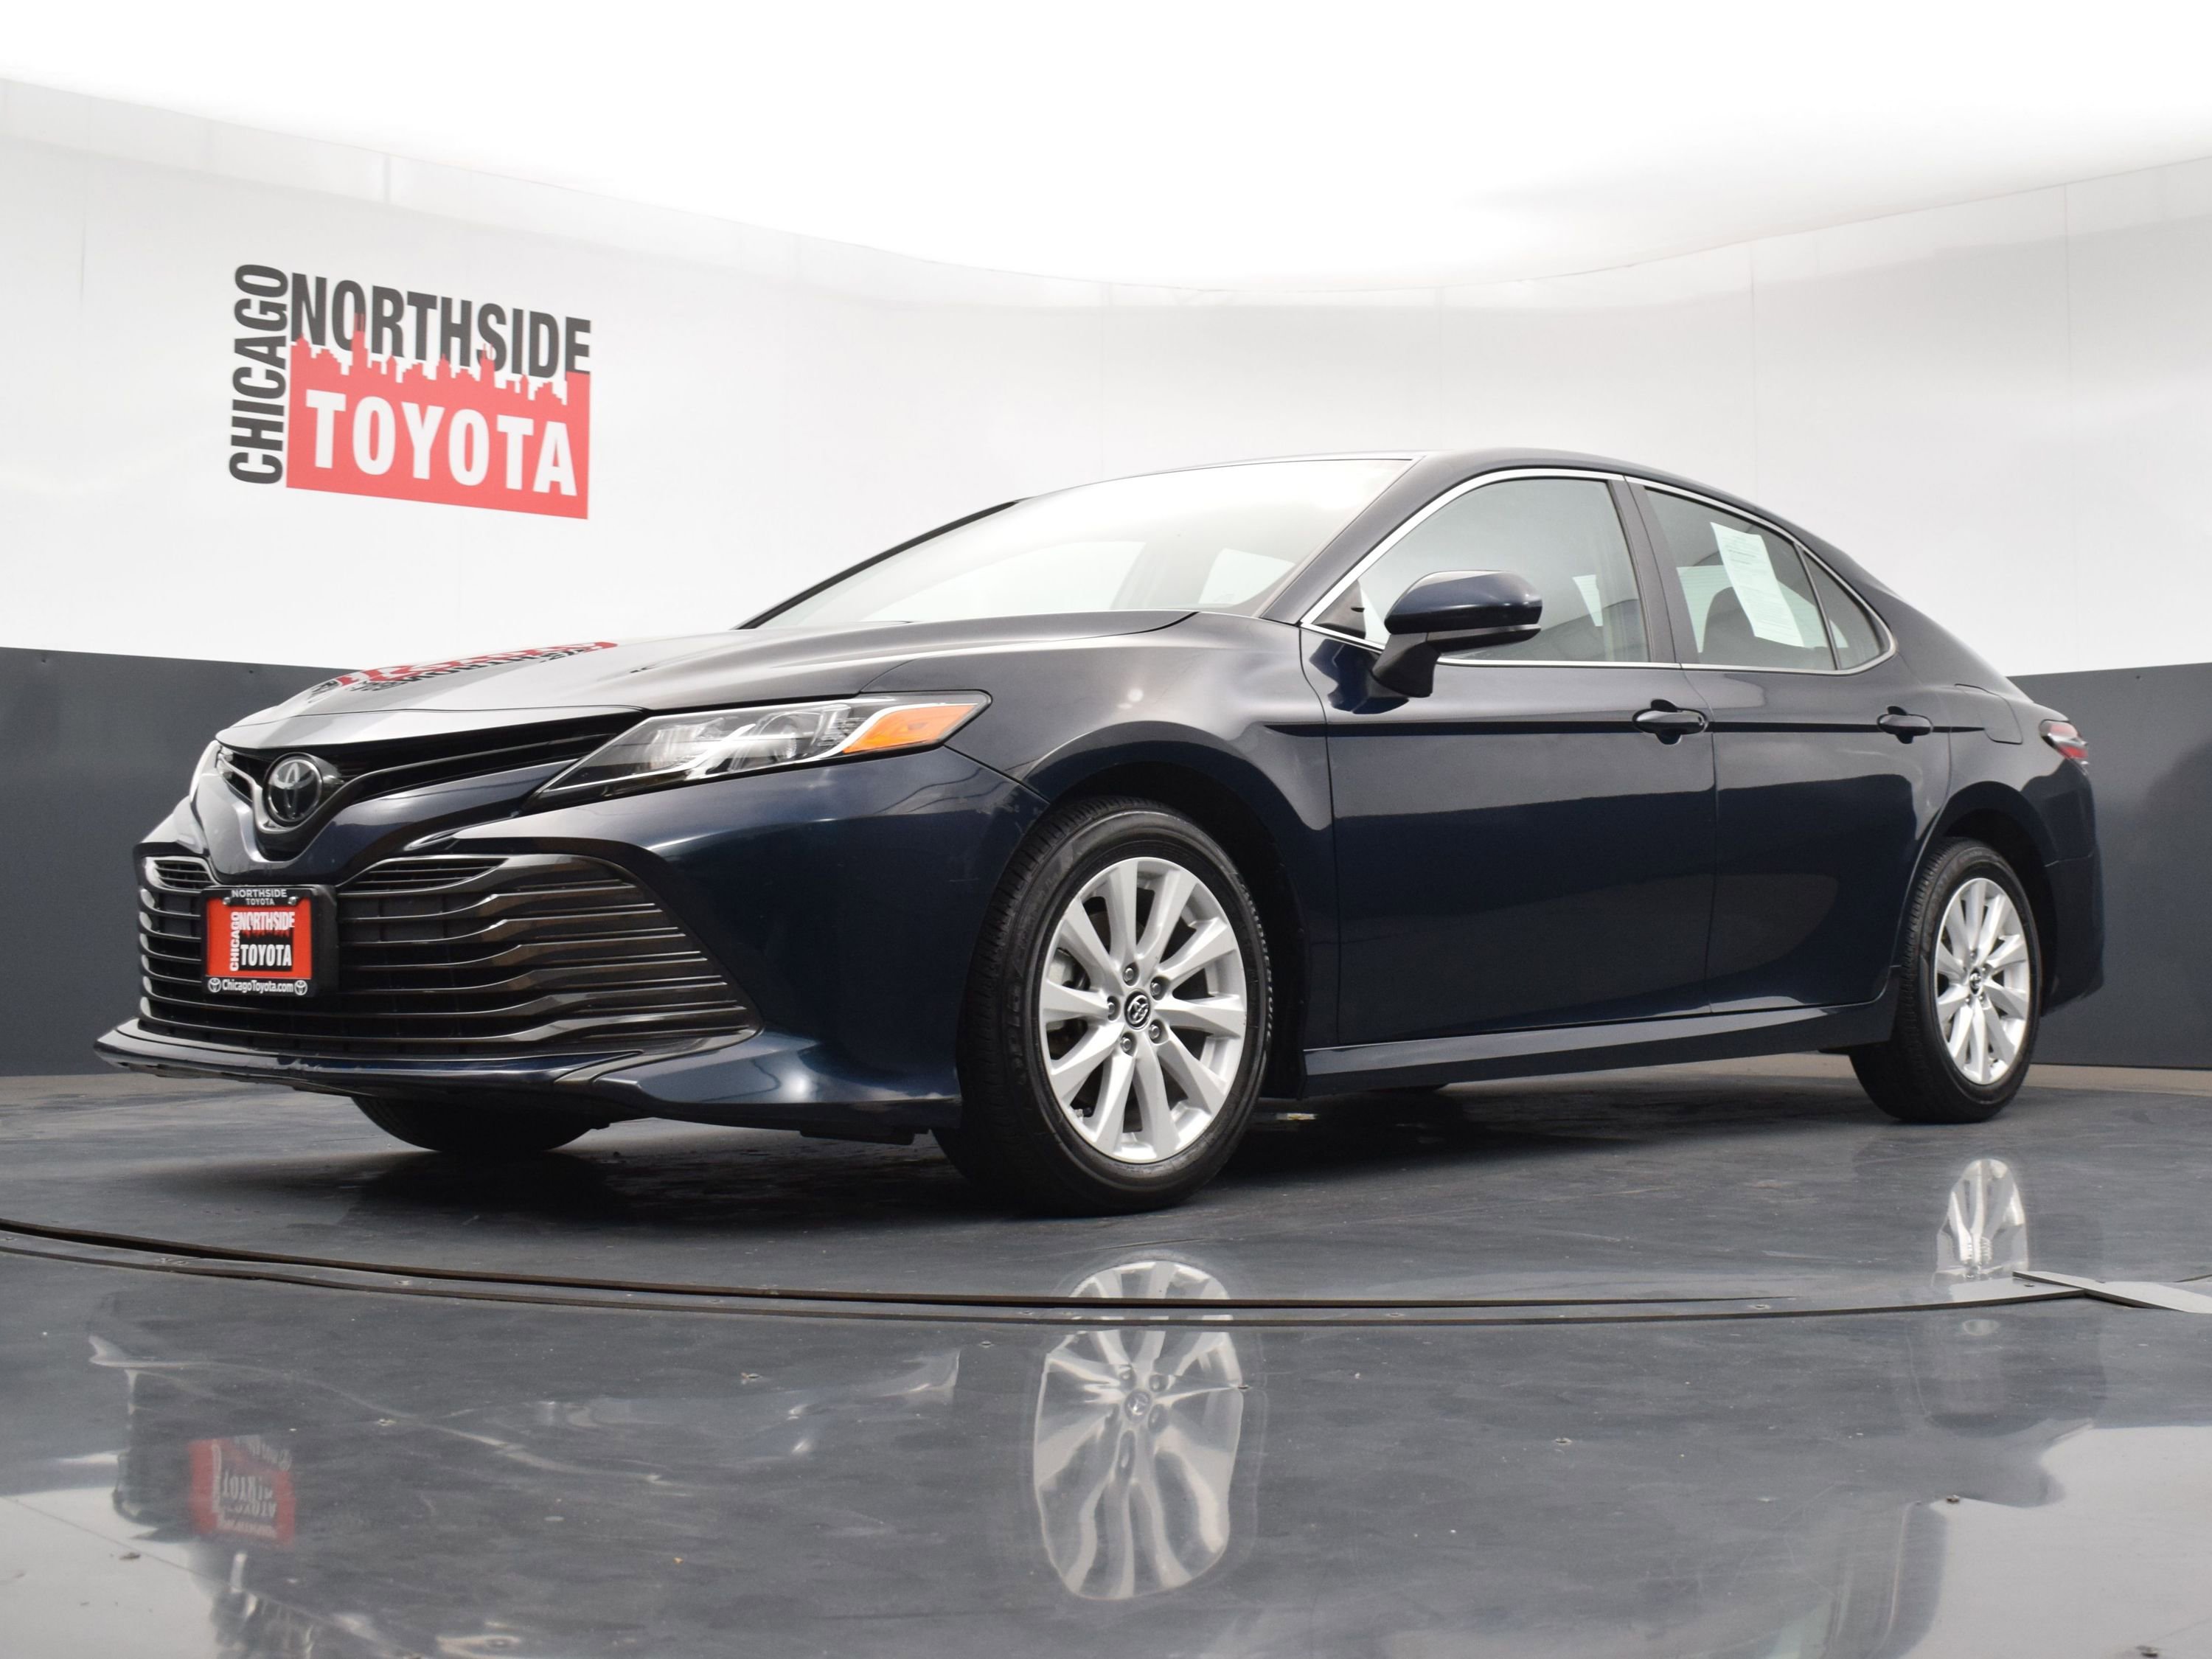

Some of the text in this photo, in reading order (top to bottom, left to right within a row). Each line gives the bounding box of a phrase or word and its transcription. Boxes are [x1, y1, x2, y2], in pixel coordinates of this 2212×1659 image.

[291, 272, 591, 379] NORTHSIDE
[229, 264, 288, 484] CHICAGO
[305, 389, 577, 496] TOYOTA
[232, 889, 287, 897] NORTHSIDE
[229, 911, 240, 972] CHICAGO
[240, 911, 295, 931] NORTHSIDE
[240, 944, 292, 966] TOYOTA
[222, 979, 293, 993] ChicagoToyota.com
